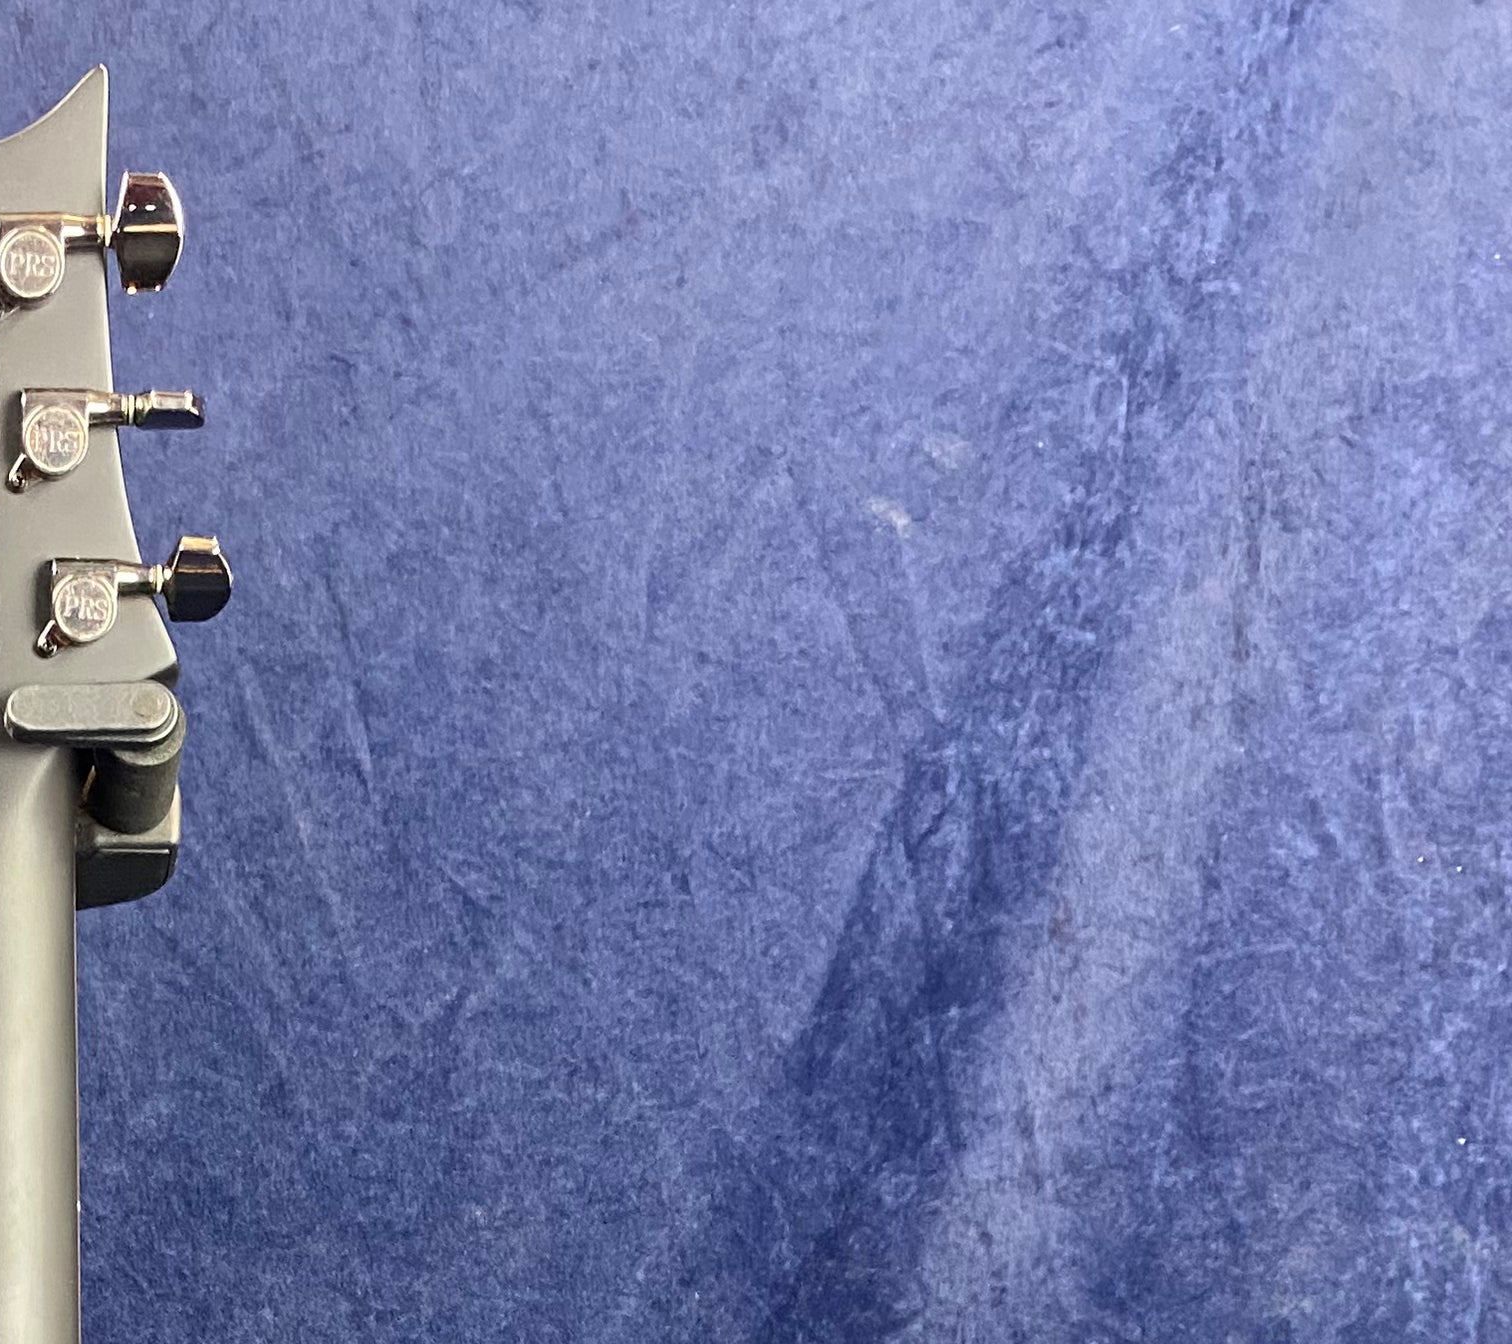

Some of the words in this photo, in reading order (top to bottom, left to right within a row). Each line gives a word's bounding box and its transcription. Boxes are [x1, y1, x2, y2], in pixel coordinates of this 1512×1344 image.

[8, 251, 56, 277] PRS
[32, 425, 80, 453] PRS
[62, 595, 109, 621] PRS
